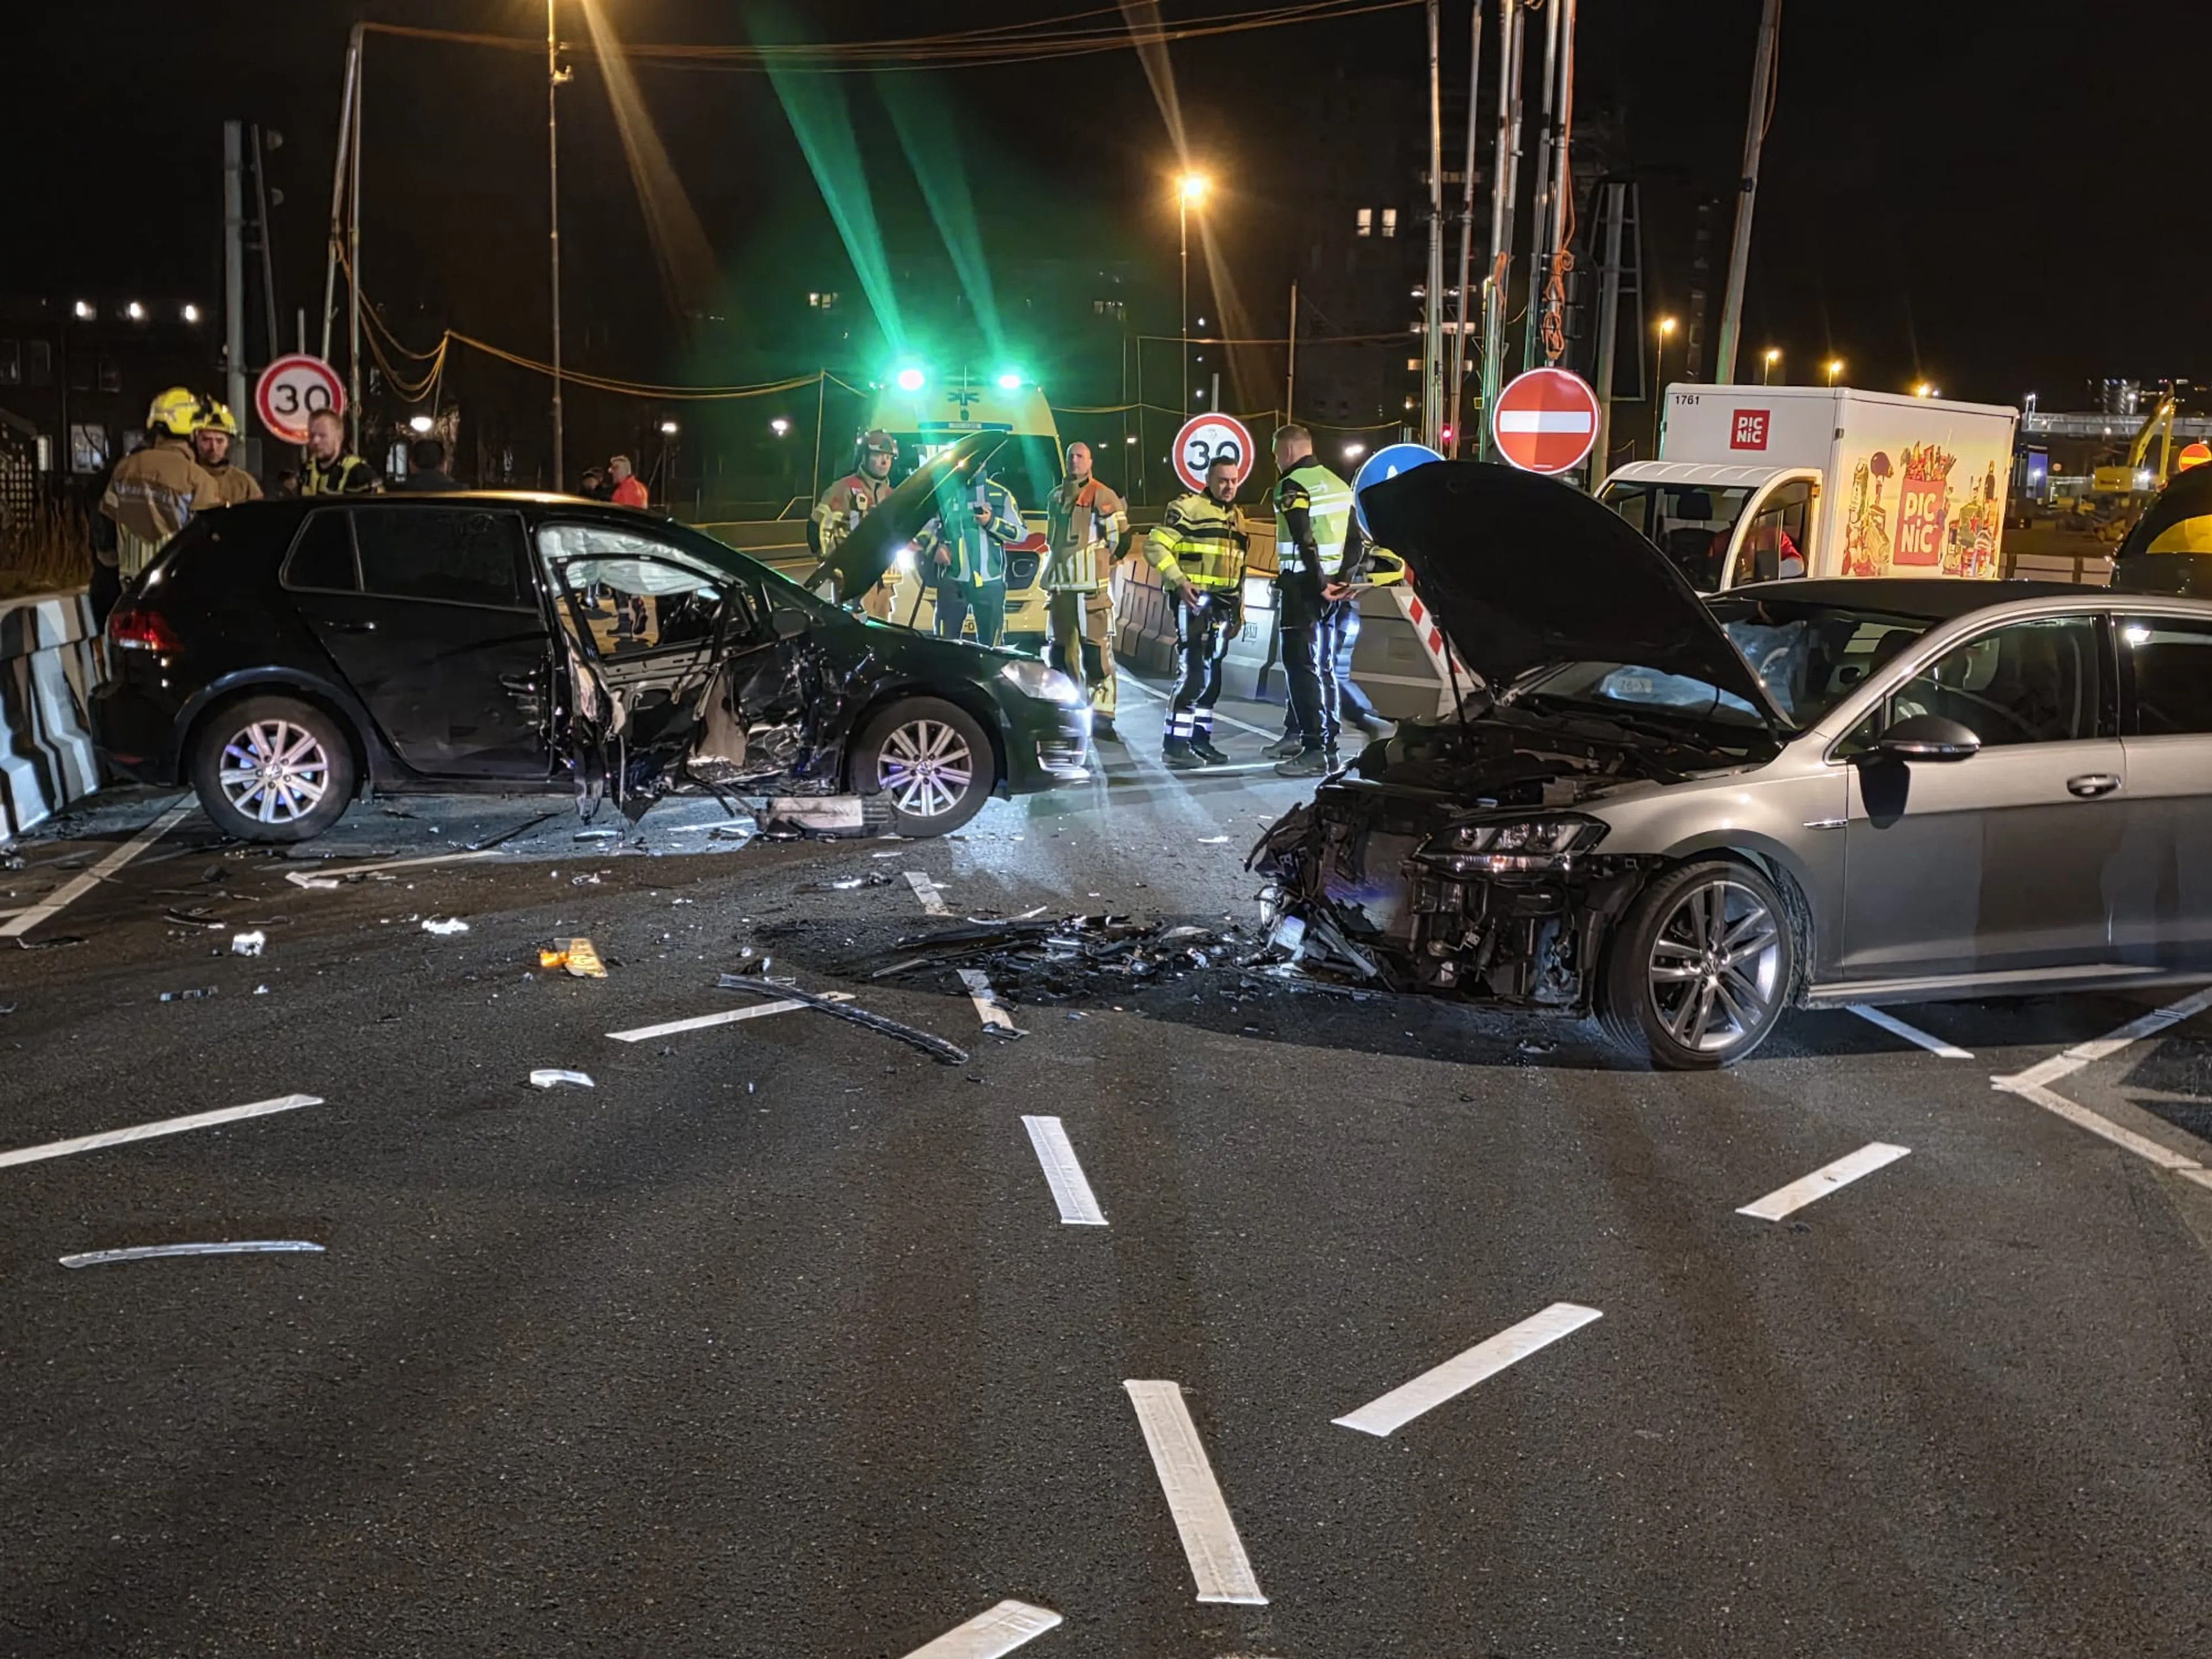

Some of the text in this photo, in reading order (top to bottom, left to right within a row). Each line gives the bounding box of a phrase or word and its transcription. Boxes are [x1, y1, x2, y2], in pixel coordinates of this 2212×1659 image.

[275, 384, 331, 415] 30
[1676, 395, 1700, 405] 1761
[1737, 416, 1763, 430] PIC
[1188, 440, 1240, 471] 30
[1904, 492, 1936, 521] PIC
